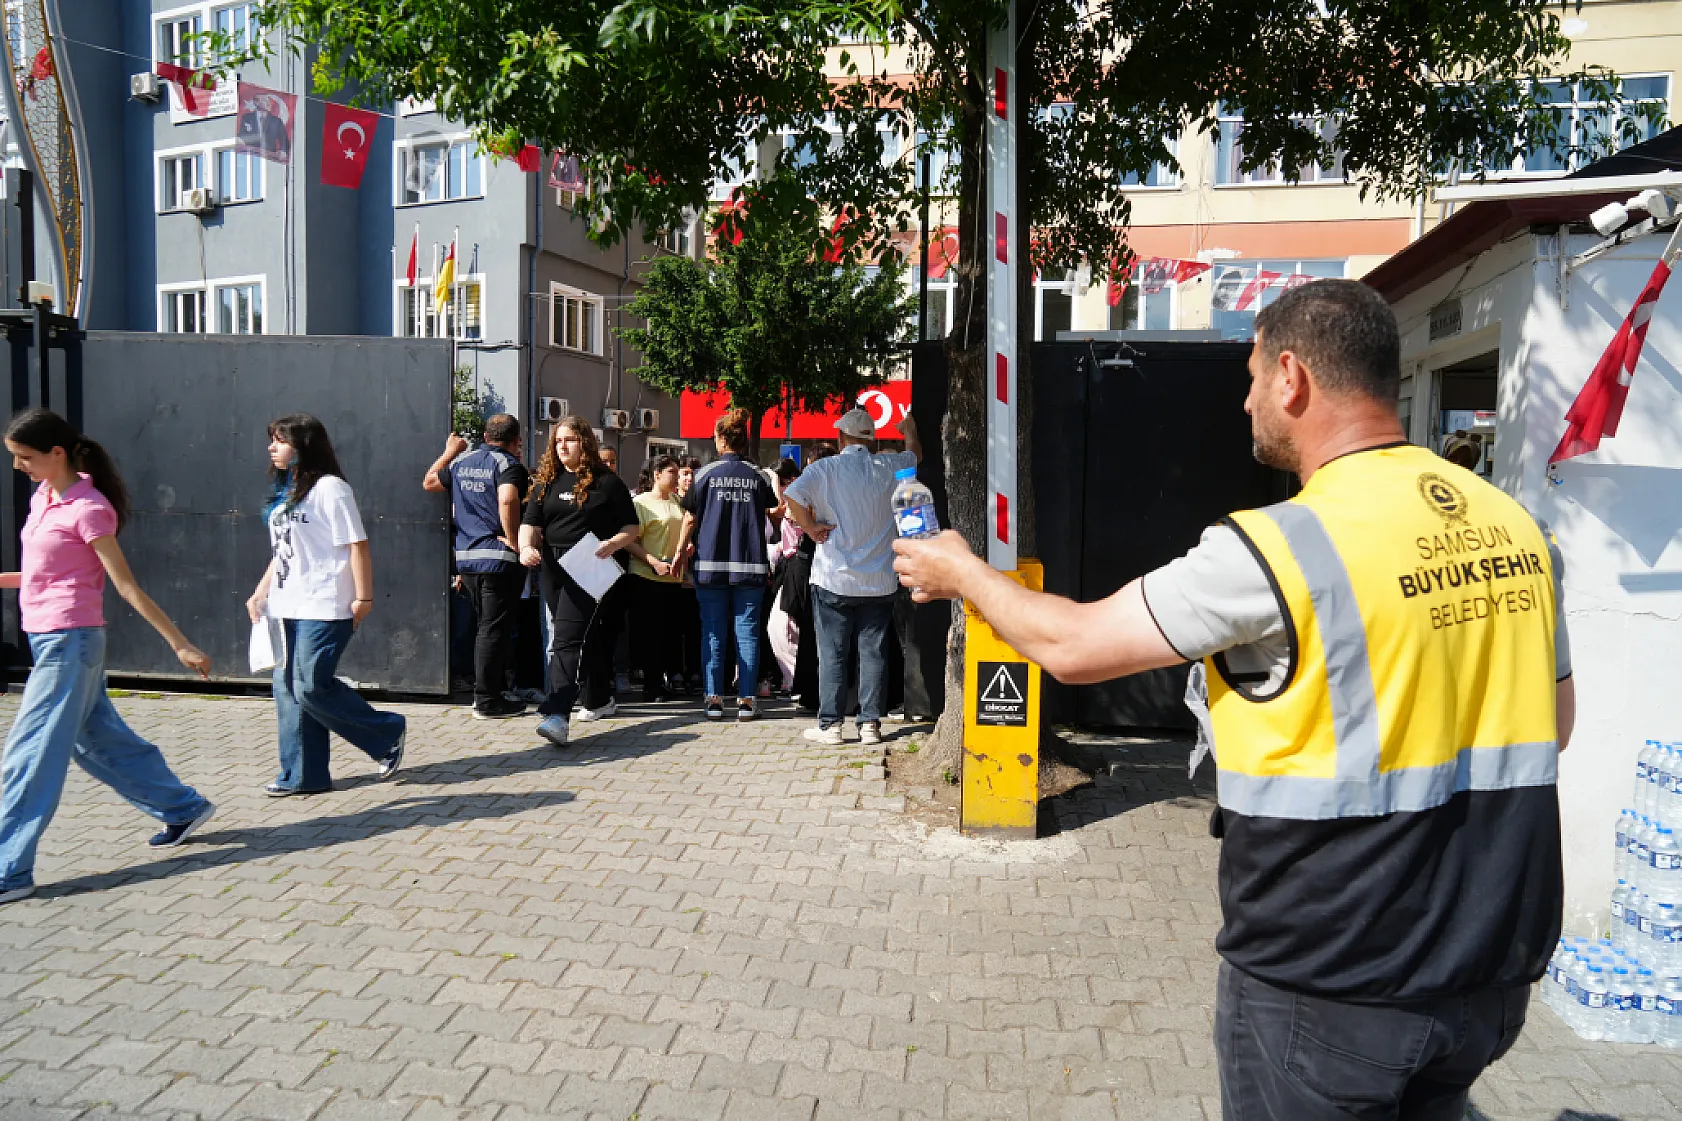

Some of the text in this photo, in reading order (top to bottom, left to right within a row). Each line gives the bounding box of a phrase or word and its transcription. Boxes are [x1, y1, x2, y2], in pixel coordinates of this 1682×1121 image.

[457, 466, 493, 479] SAMSUN
[709, 476, 757, 490] SAMSUN
[1416, 525, 1513, 560] SAMSUN
[1398, 549, 1544, 599] BÜYÜKŞEHİR
[1430, 584, 1538, 630] BELEDYESİ
